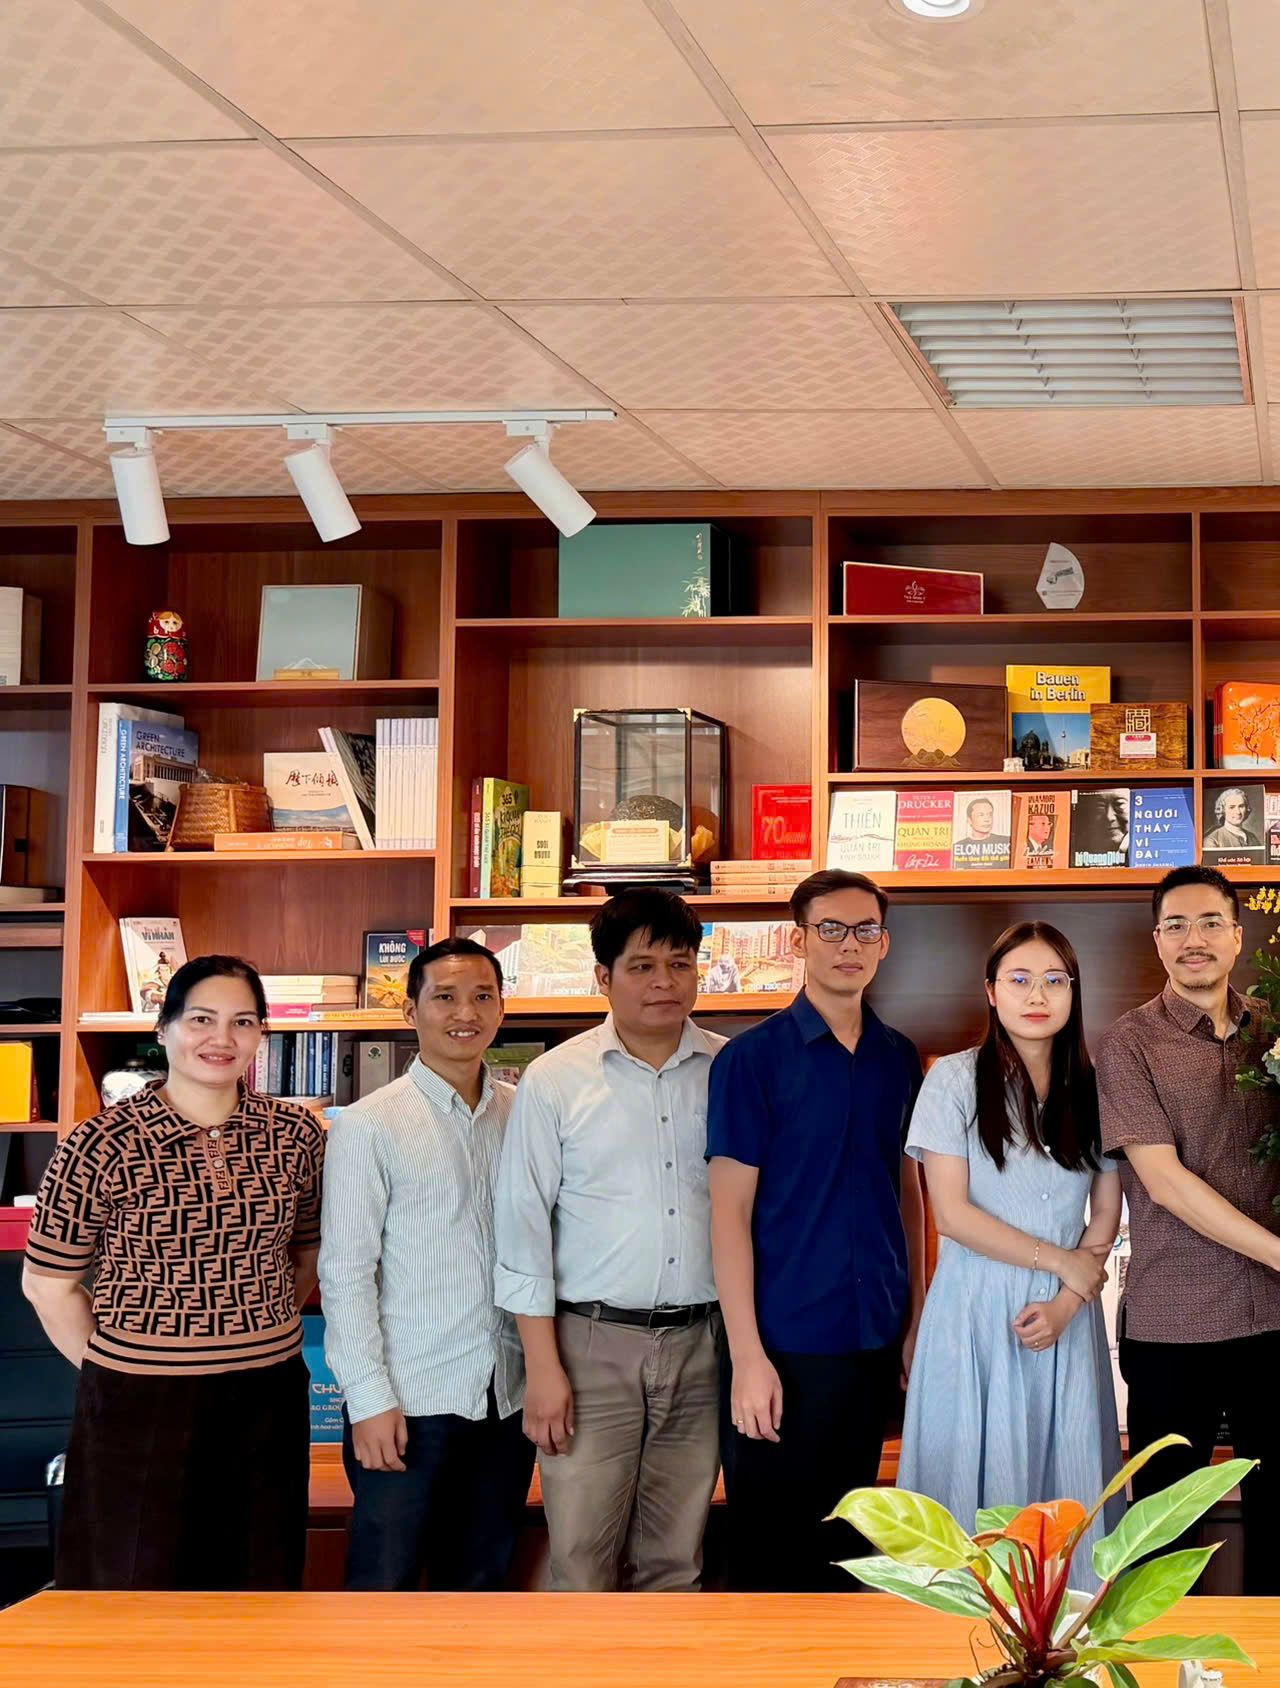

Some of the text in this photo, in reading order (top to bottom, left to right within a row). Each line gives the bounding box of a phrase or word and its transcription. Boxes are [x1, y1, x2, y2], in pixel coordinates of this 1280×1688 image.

[1036, 672, 1080, 687] Bauen
[1030, 687, 1086, 701] in Berlin
[136, 730, 160, 742] GREEN
[136, 741, 185, 758] ARCHITECTURE
[118, 729, 128, 800] GREEN ARCHITECTURE
[501, 793, 513, 805] 365
[898, 800, 952, 809] DRUCKER
[1135, 795, 1143, 806] 3
[1028, 803, 1055, 815] KAZUO
[954, 842, 1010, 856] ELON MUSK
[379, 940, 406, 953] KHÔNG
